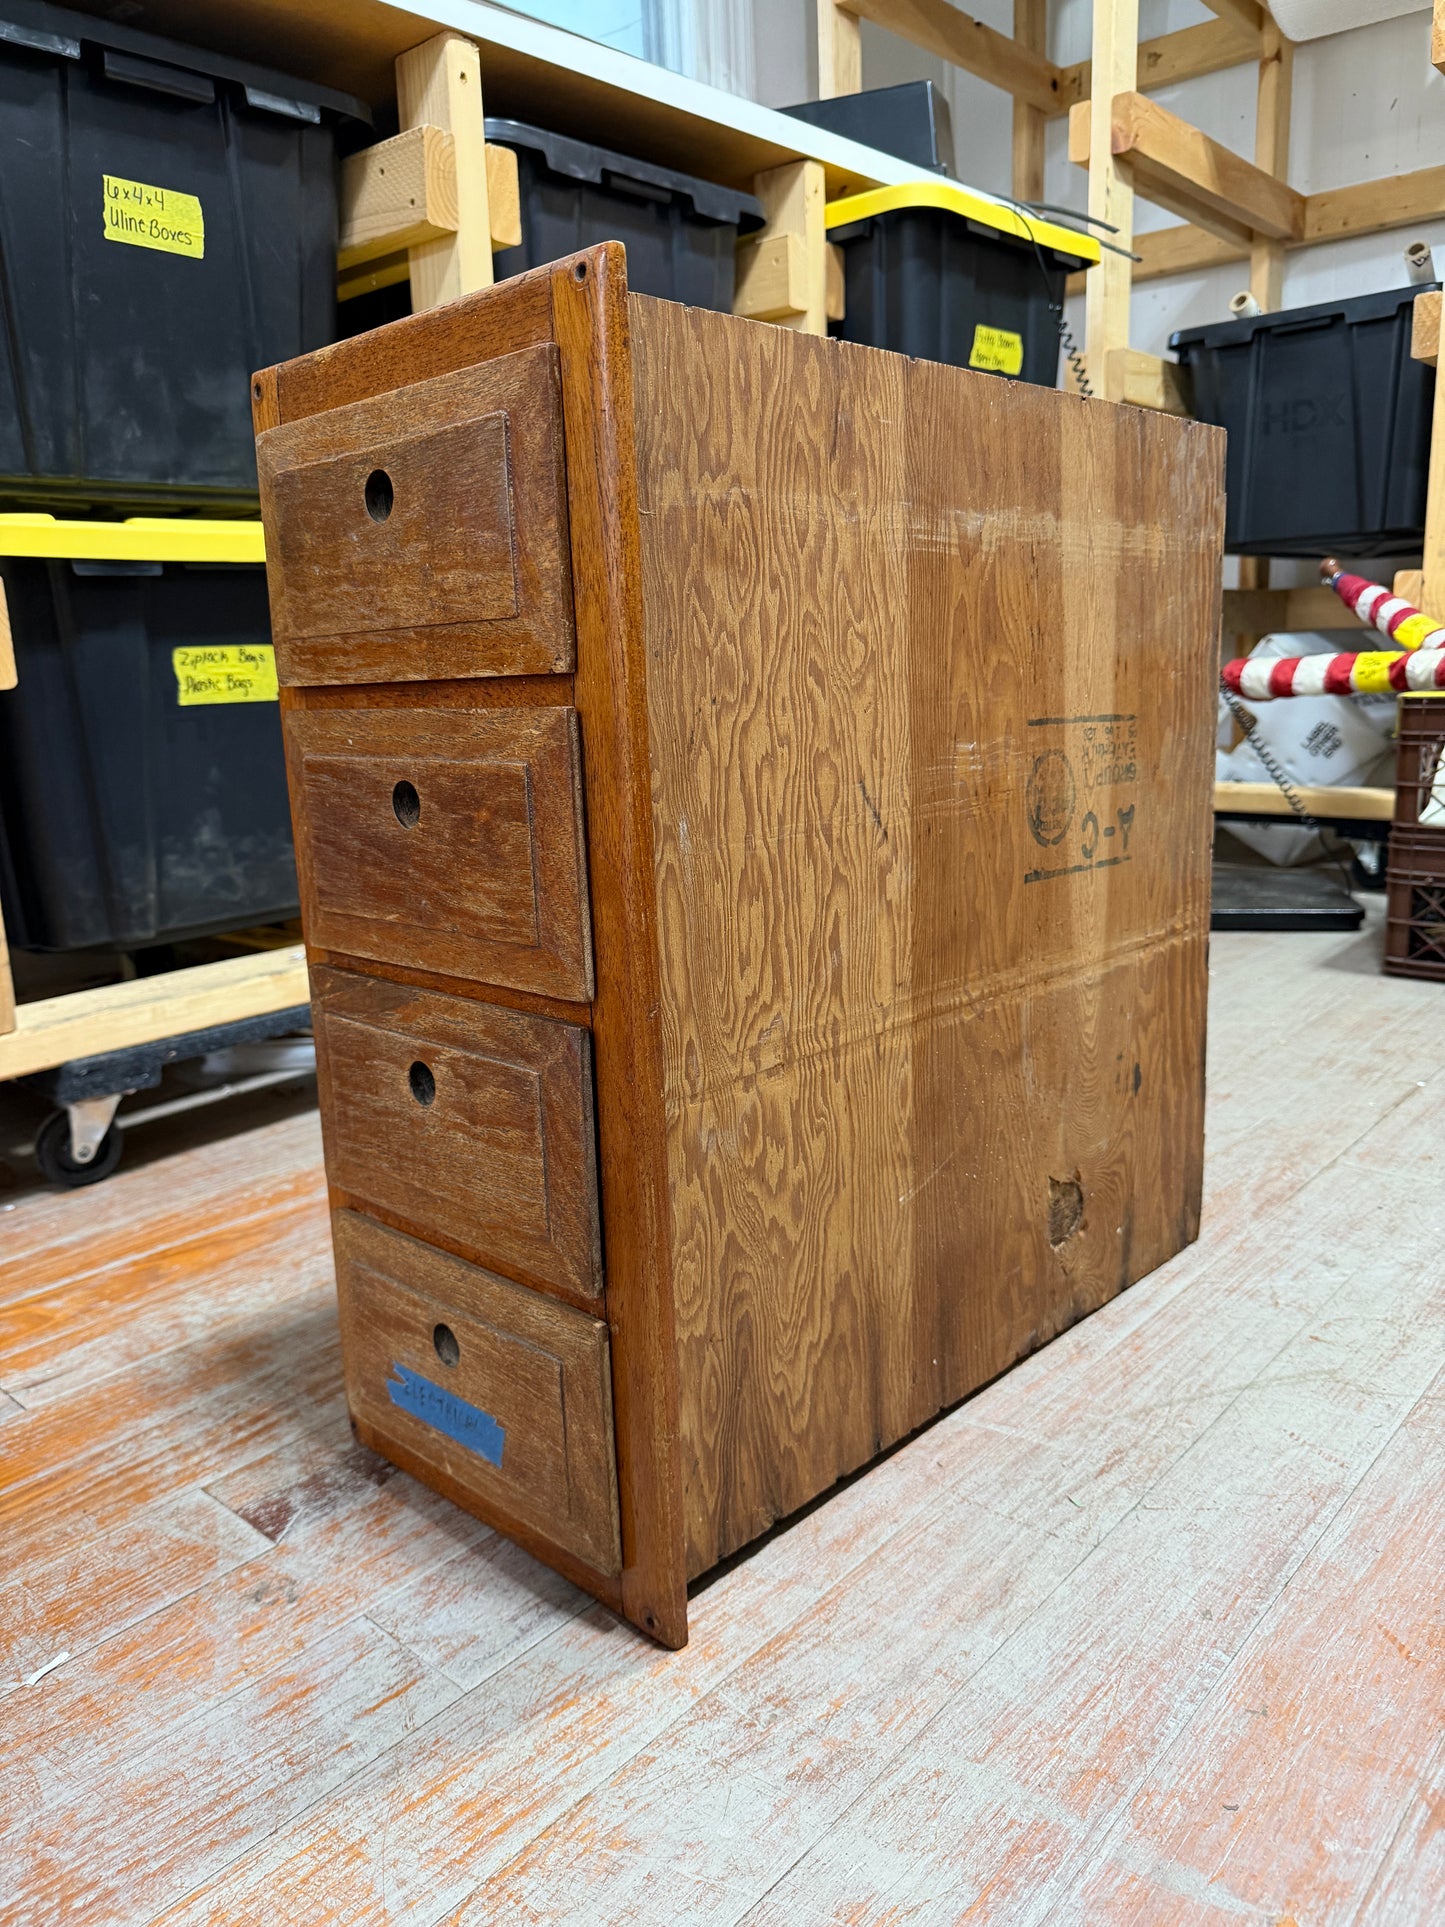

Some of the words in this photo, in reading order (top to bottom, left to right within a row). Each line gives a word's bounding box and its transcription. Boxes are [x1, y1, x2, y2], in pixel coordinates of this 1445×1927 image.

[110, 206, 145, 233] Uline
[149, 219, 192, 246] Boxes
[1262, 391, 1346, 436] HDX
[238, 648, 266, 671] Bags
[226, 674, 254, 697] Bags
[1095, 763, 1137, 787] GROUP
[1081, 804, 1135, 859] A-C
